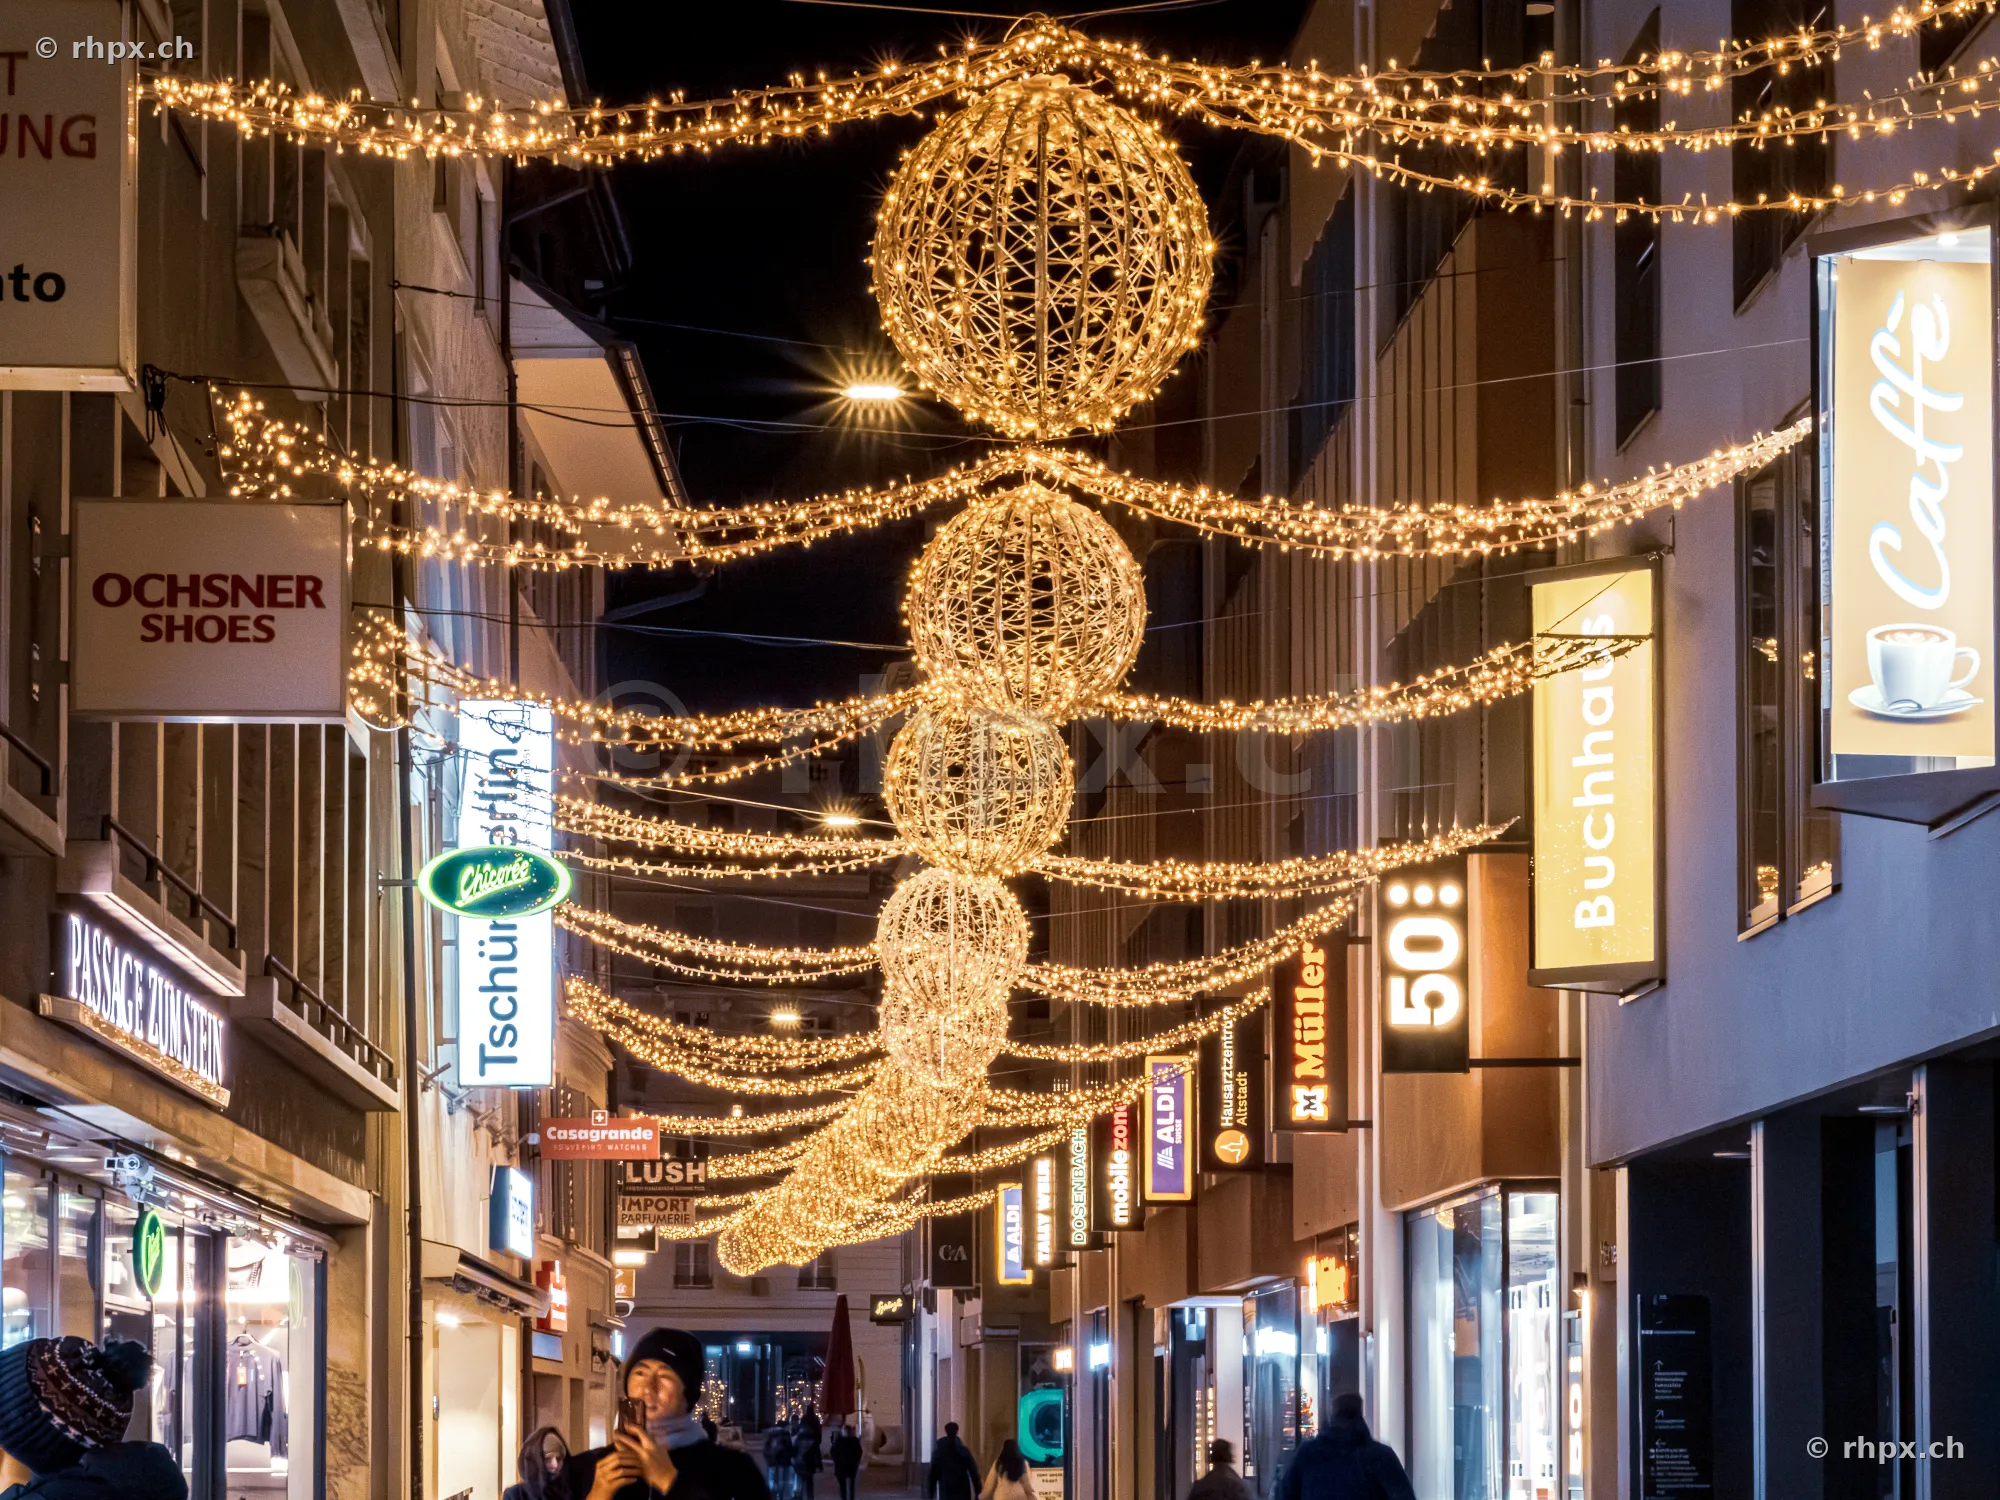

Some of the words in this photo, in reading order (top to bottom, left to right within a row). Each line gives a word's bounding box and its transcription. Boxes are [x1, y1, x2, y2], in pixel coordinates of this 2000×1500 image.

[0, 263, 66, 302] to
[92, 572, 327, 609] OCHSNER
[140, 614, 276, 643] SHOES
[1573, 613, 1615, 930] Buchhaus
[455, 857, 534, 908] Chicorée
[478, 748, 518, 1077] Tschüerlin
[69, 913, 144, 1043] PASSAGE
[1295, 941, 1325, 1079] Müller
[1156, 1086, 1175, 1145] ALDI
[1236, 1071, 1248, 1126] Altstadt
[546, 1127, 653, 1142] Casagrande
[1174, 1118, 1182, 1145] SUISSE
[626, 1161, 706, 1184] LUSH
[1071, 1128, 1088, 1246] DOSENBACH
[621, 1197, 690, 1212] IMPORT
[621, 1213, 691, 1225] PARFUMERIE
[1006, 1204, 1022, 1246] ALDI
